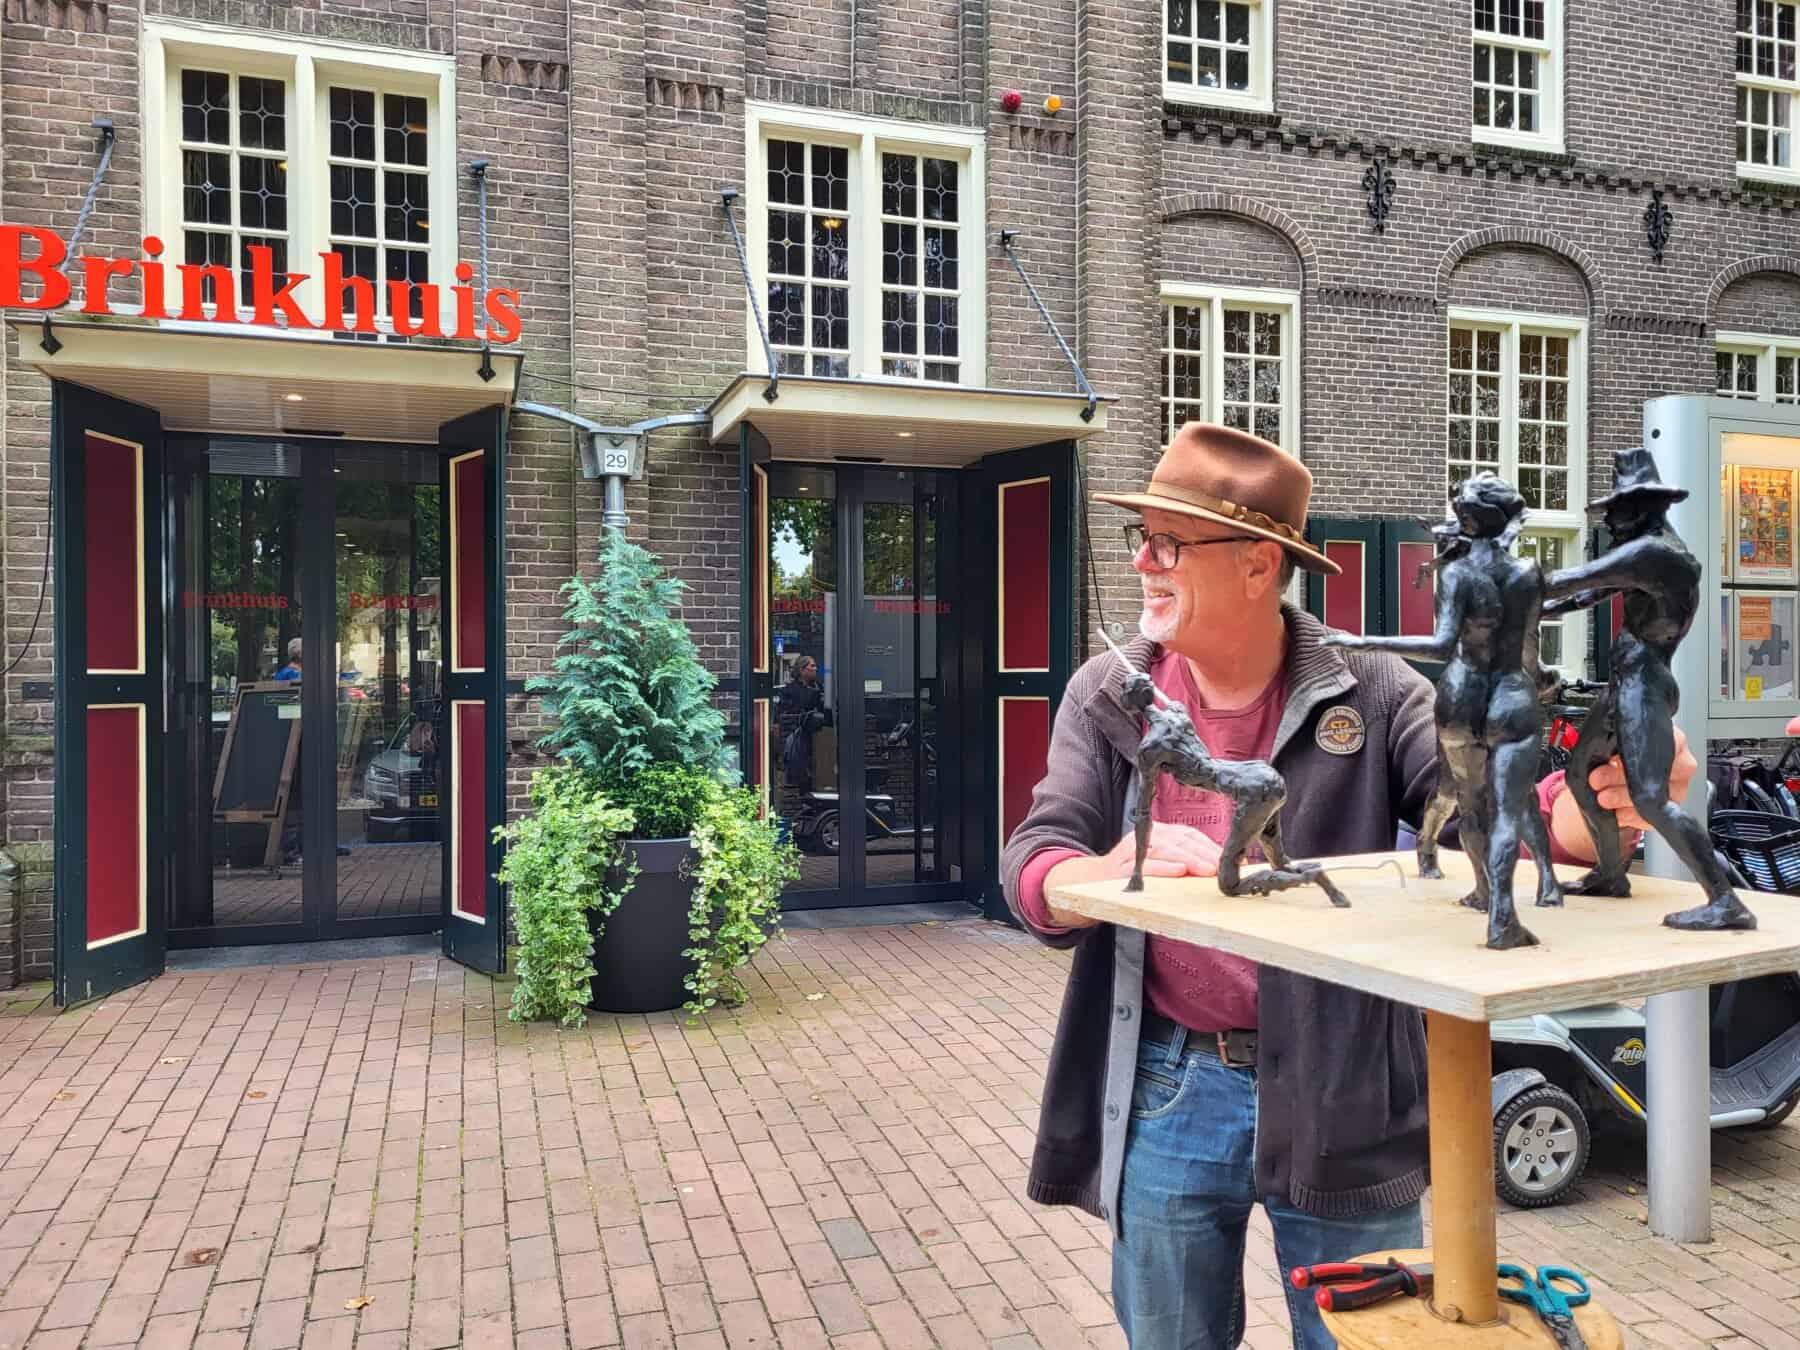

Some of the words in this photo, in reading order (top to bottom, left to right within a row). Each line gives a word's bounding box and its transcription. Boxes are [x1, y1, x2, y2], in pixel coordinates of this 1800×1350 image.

[0, 225, 522, 343] Brinkhuis
[606, 454, 627, 468] 29
[181, 592, 288, 608] Brinkhuis
